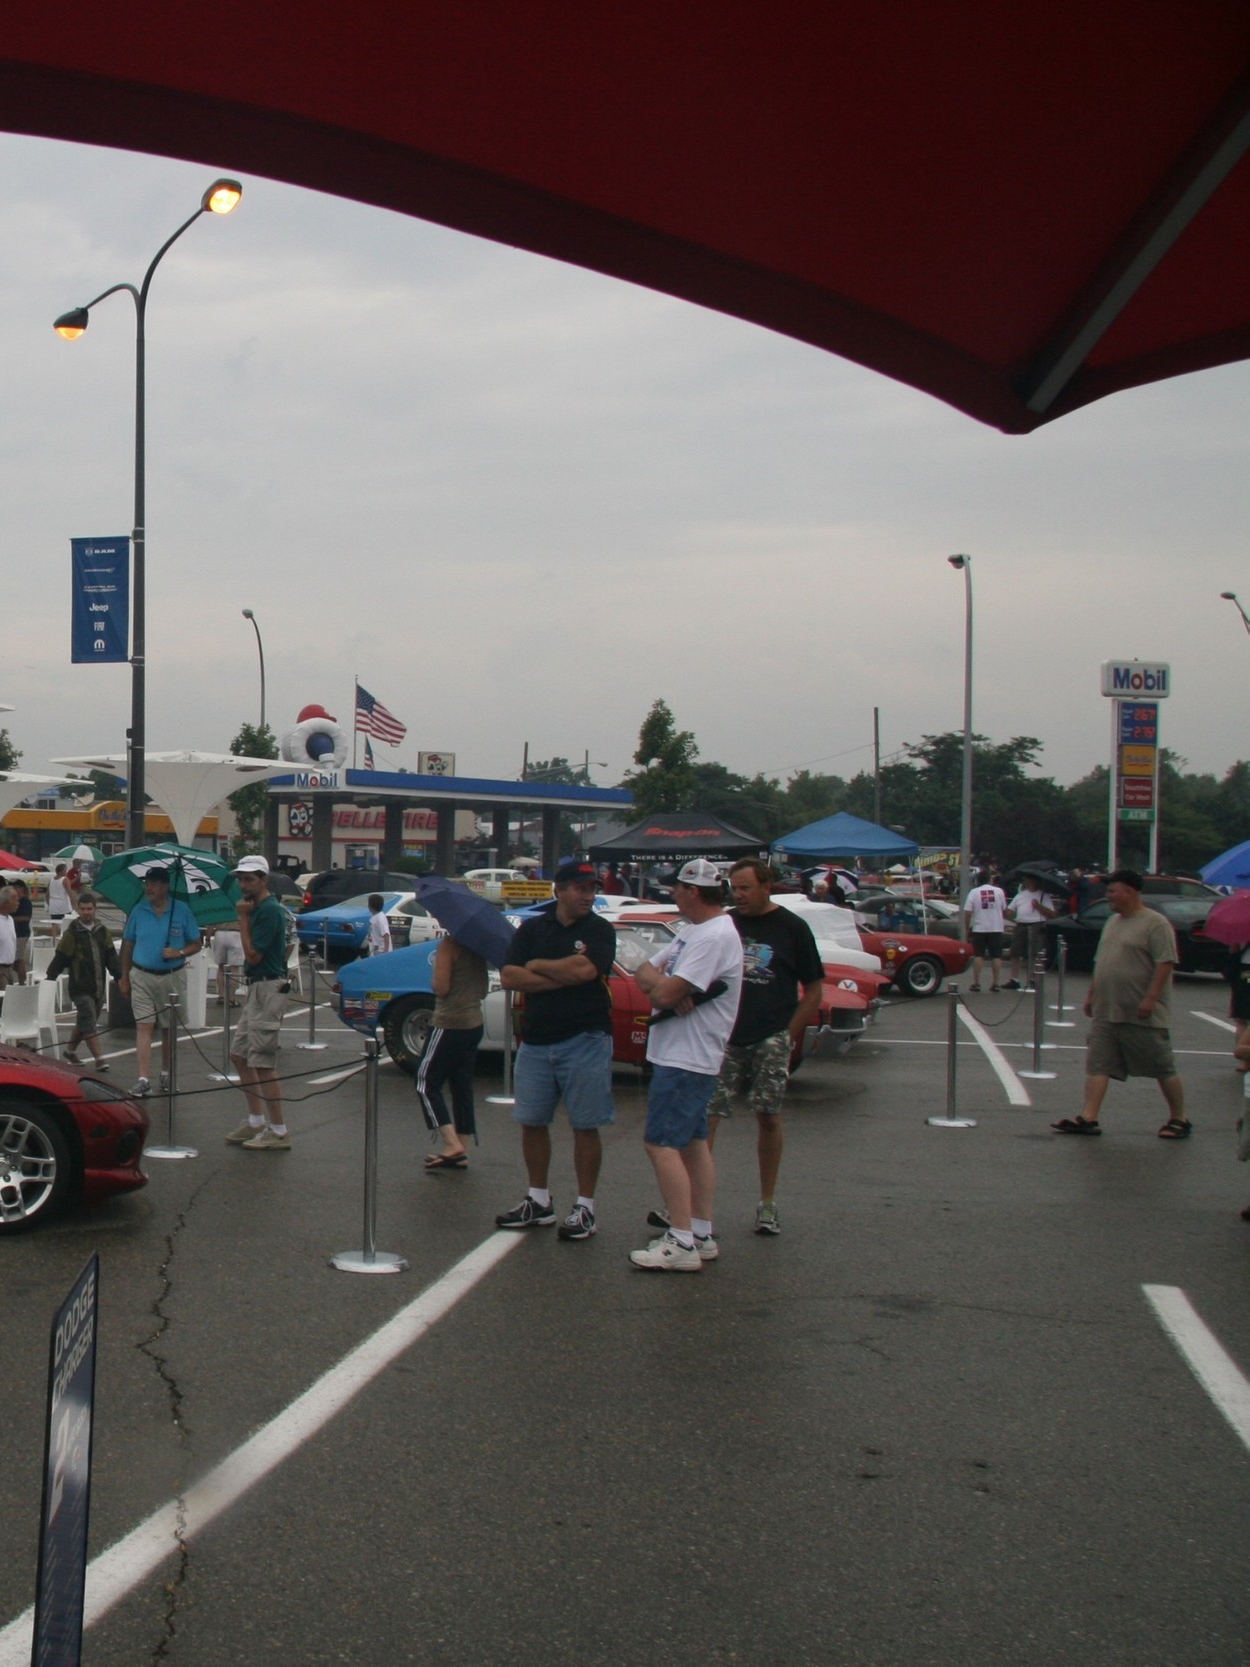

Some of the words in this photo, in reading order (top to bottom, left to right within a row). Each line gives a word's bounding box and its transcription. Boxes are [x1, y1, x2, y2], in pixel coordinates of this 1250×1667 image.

[89, 603, 109, 612] Jeep
[1113, 667, 1166, 690] Mobil
[296, 772, 338, 788] Mobil
[54, 1271, 95, 1369] DODGE
